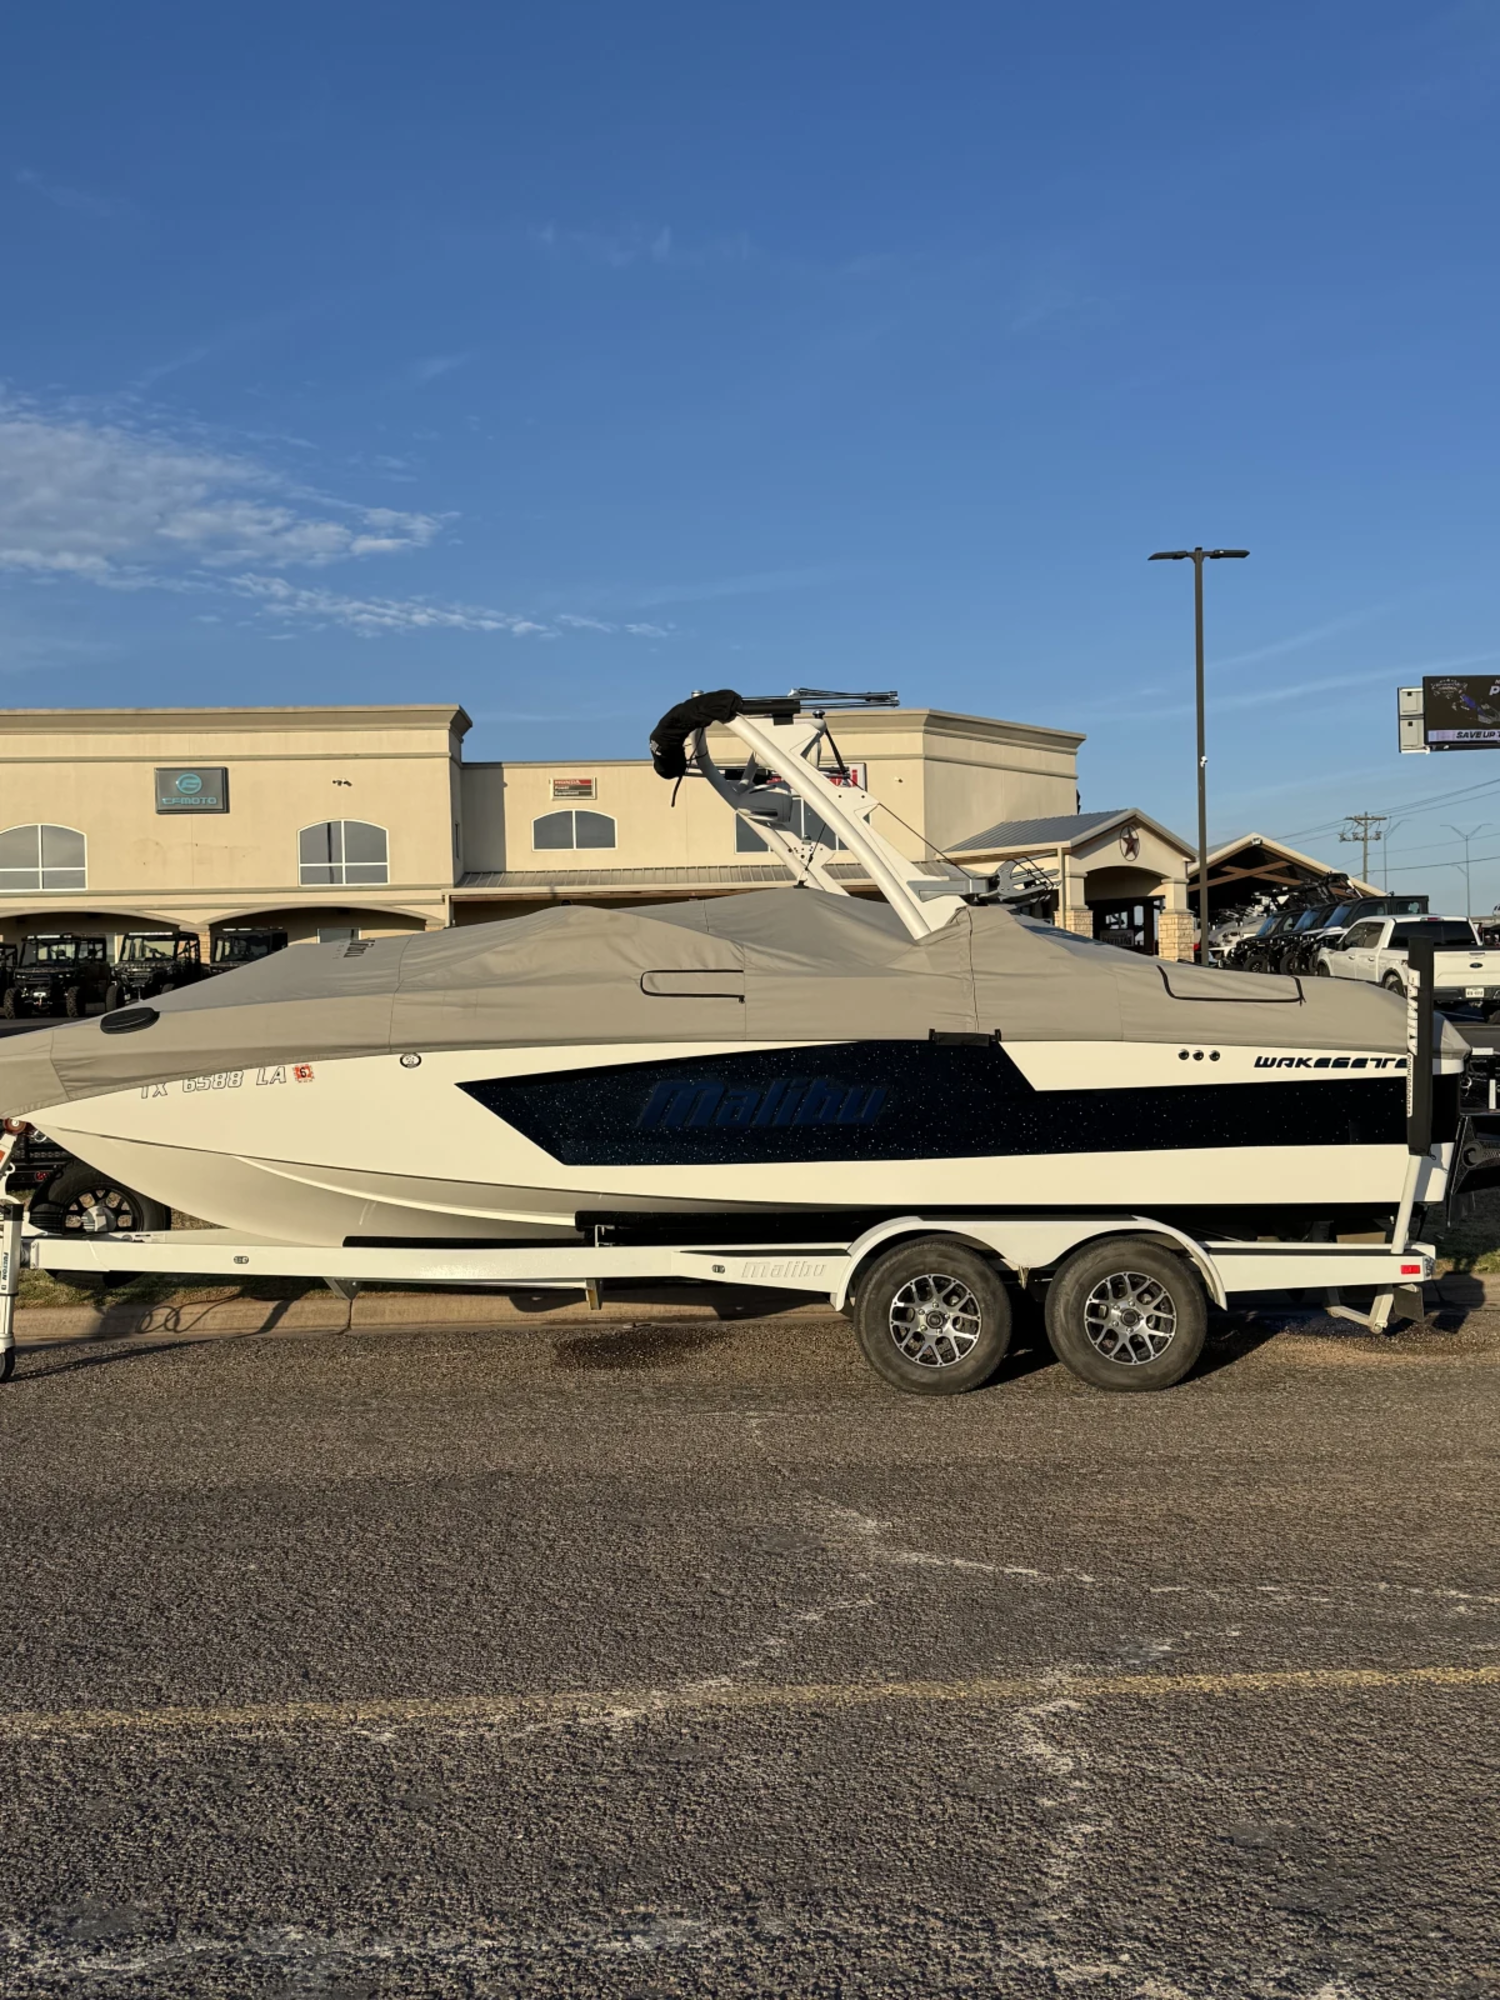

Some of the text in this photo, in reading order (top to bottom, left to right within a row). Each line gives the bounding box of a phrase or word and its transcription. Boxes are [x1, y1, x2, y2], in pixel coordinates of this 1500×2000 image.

[1456, 731, 1482, 739] SAVE
[162, 797, 217, 805] CFMOTO
[1253, 1056, 1408, 1068] WAKESETTE
[182, 1071, 244, 1093] 6588
[256, 1066, 287, 1085] LA
[636, 1079, 888, 1127] Malibu
[741, 1261, 827, 1278] Malibu
